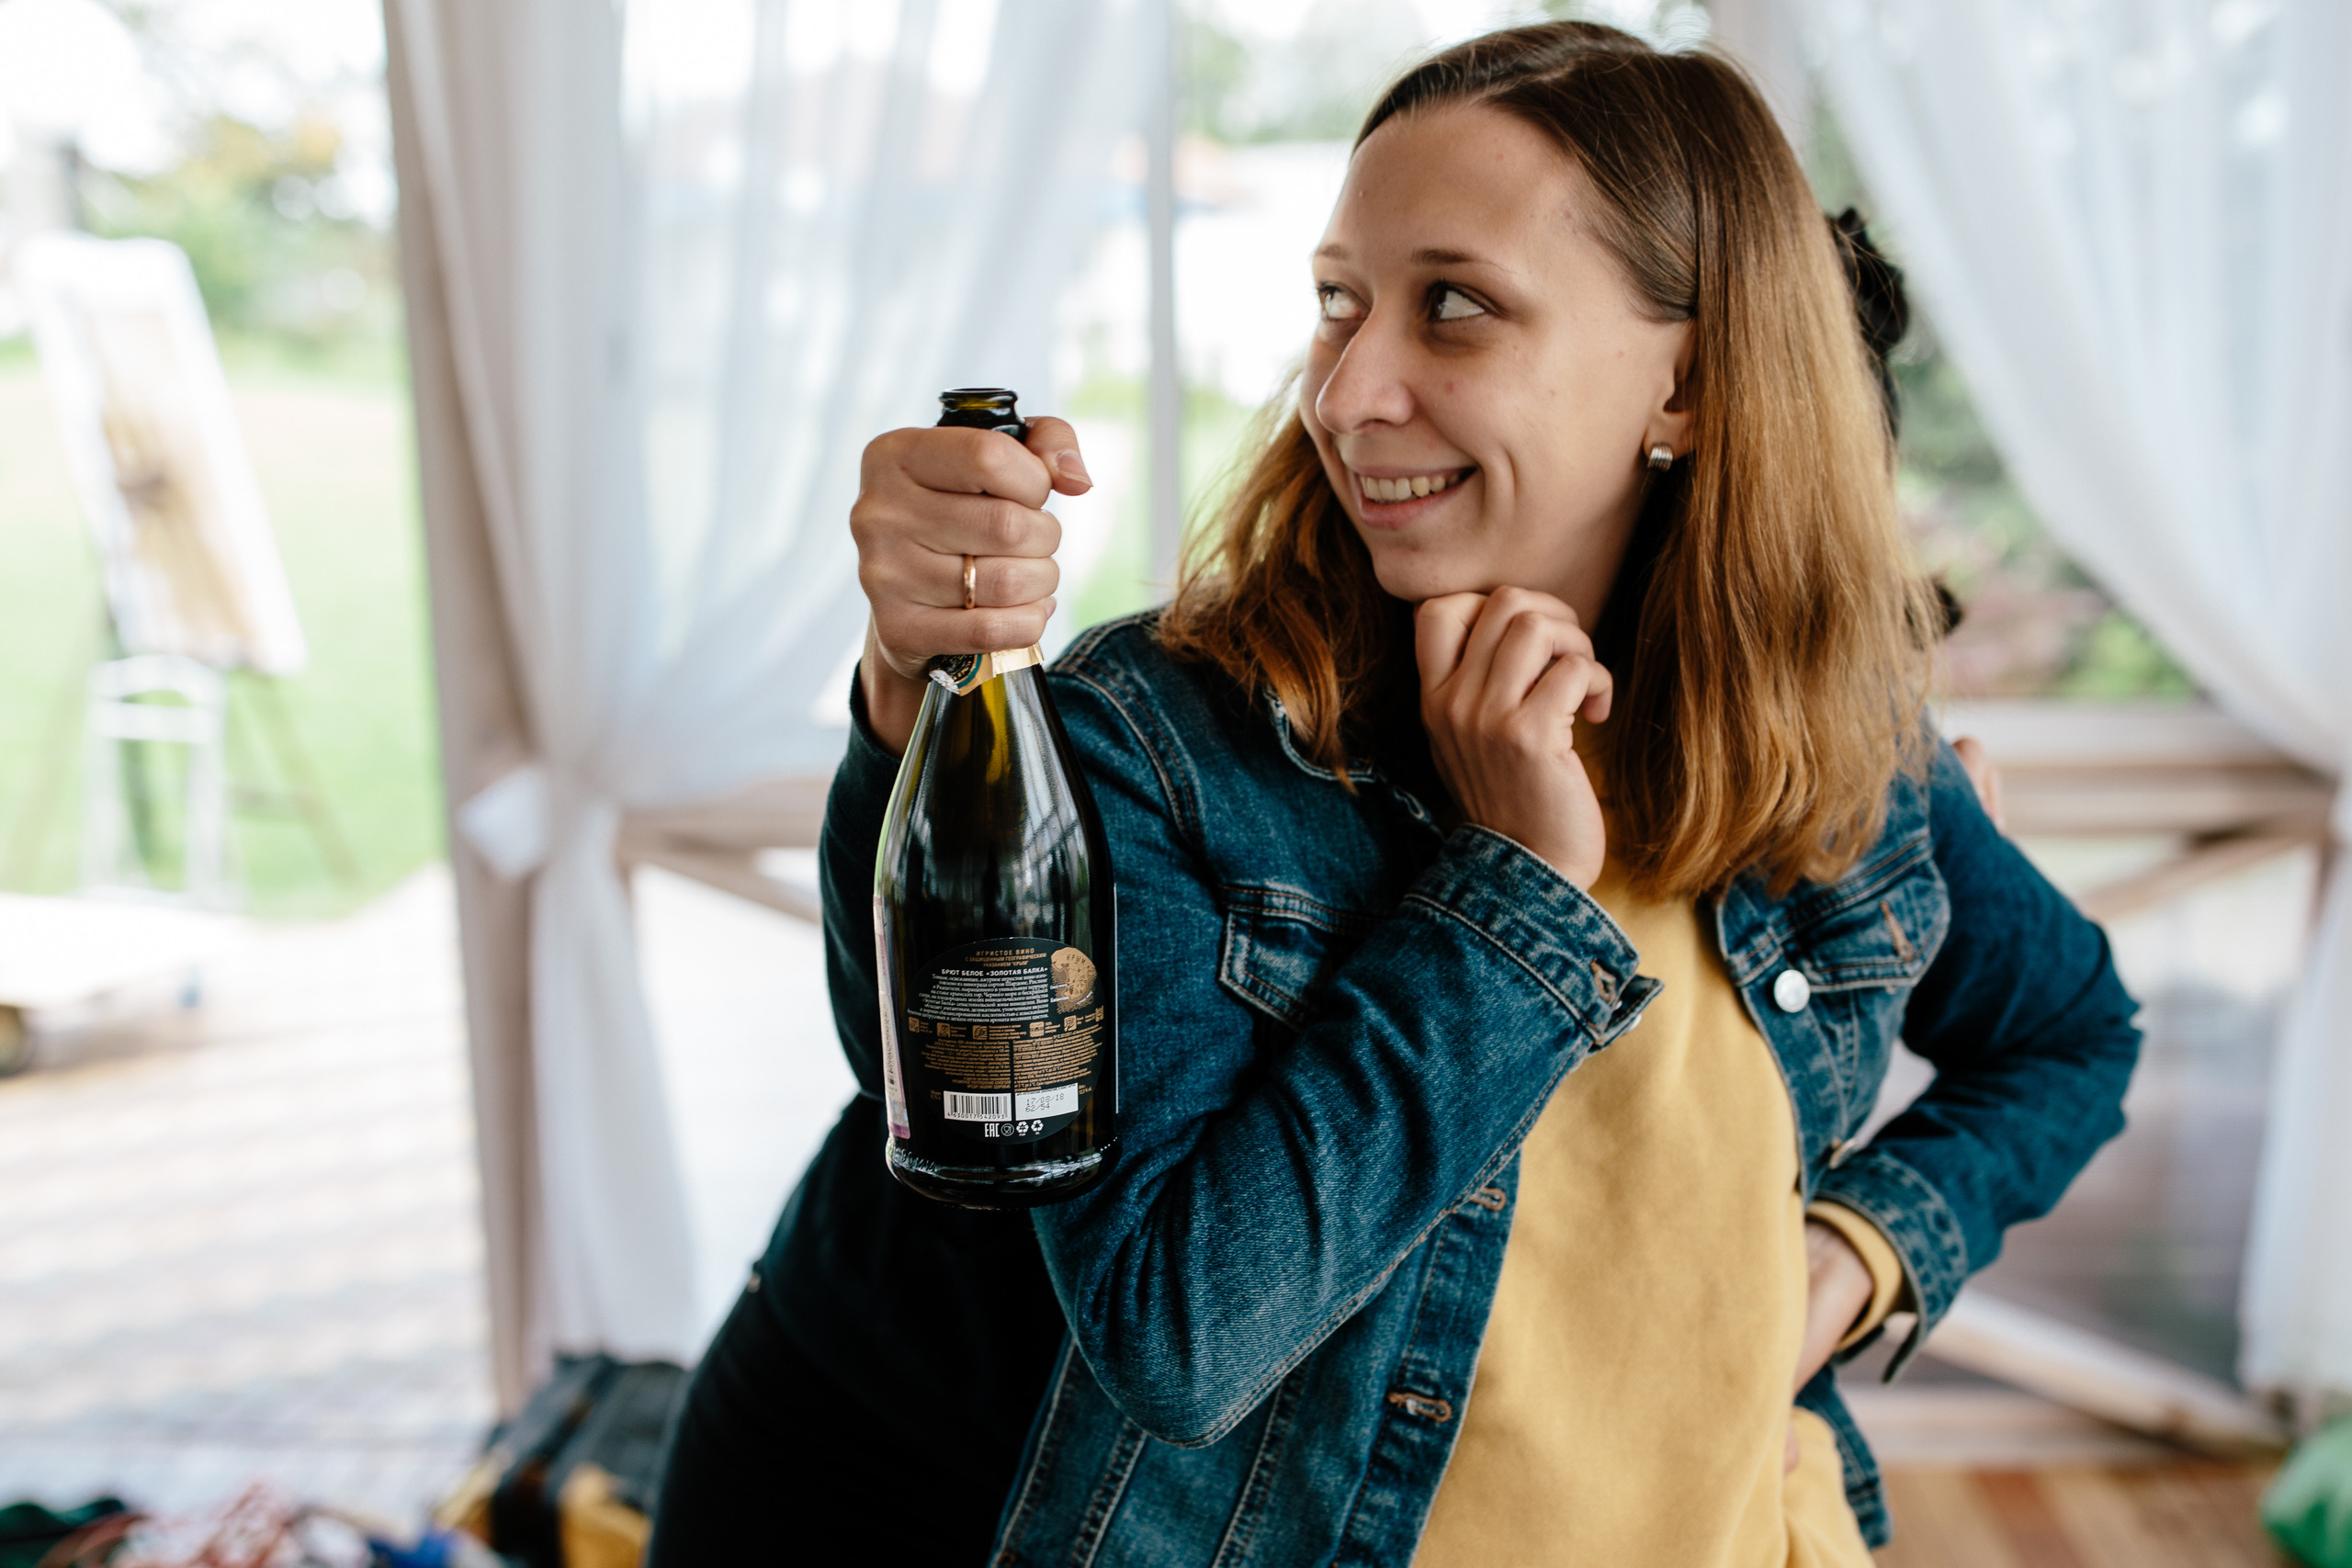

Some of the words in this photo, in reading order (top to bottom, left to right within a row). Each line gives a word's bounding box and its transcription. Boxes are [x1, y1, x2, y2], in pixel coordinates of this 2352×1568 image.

[1067, 954, 1086, 964] КРЫМ
[1027, 1093, 1065, 1106] 17/08/18
[1025, 1103, 1050, 1112] 62/54
[985, 1123, 1000, 1137] EAC
